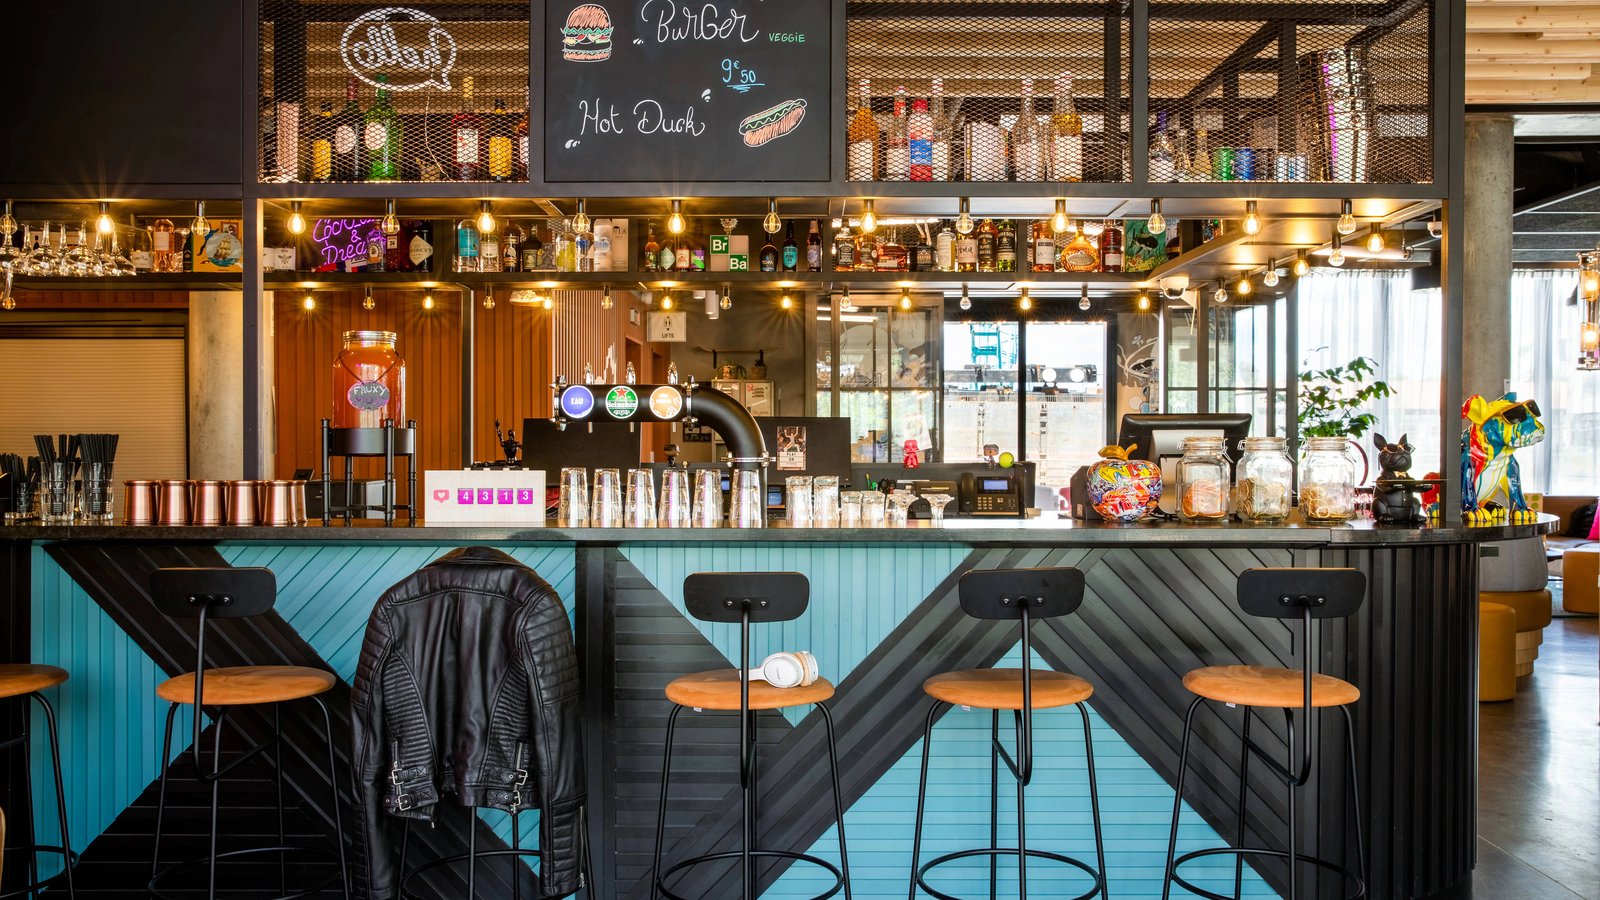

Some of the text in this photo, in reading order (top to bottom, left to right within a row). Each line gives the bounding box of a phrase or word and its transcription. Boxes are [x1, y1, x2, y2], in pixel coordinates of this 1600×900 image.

[579, 97, 706, 137] Hot Duck
[350, 229, 362, 243] &
[712, 239, 728, 251] Br
[321, 240, 367, 265] Drea
[730, 257, 747, 270] Ba
